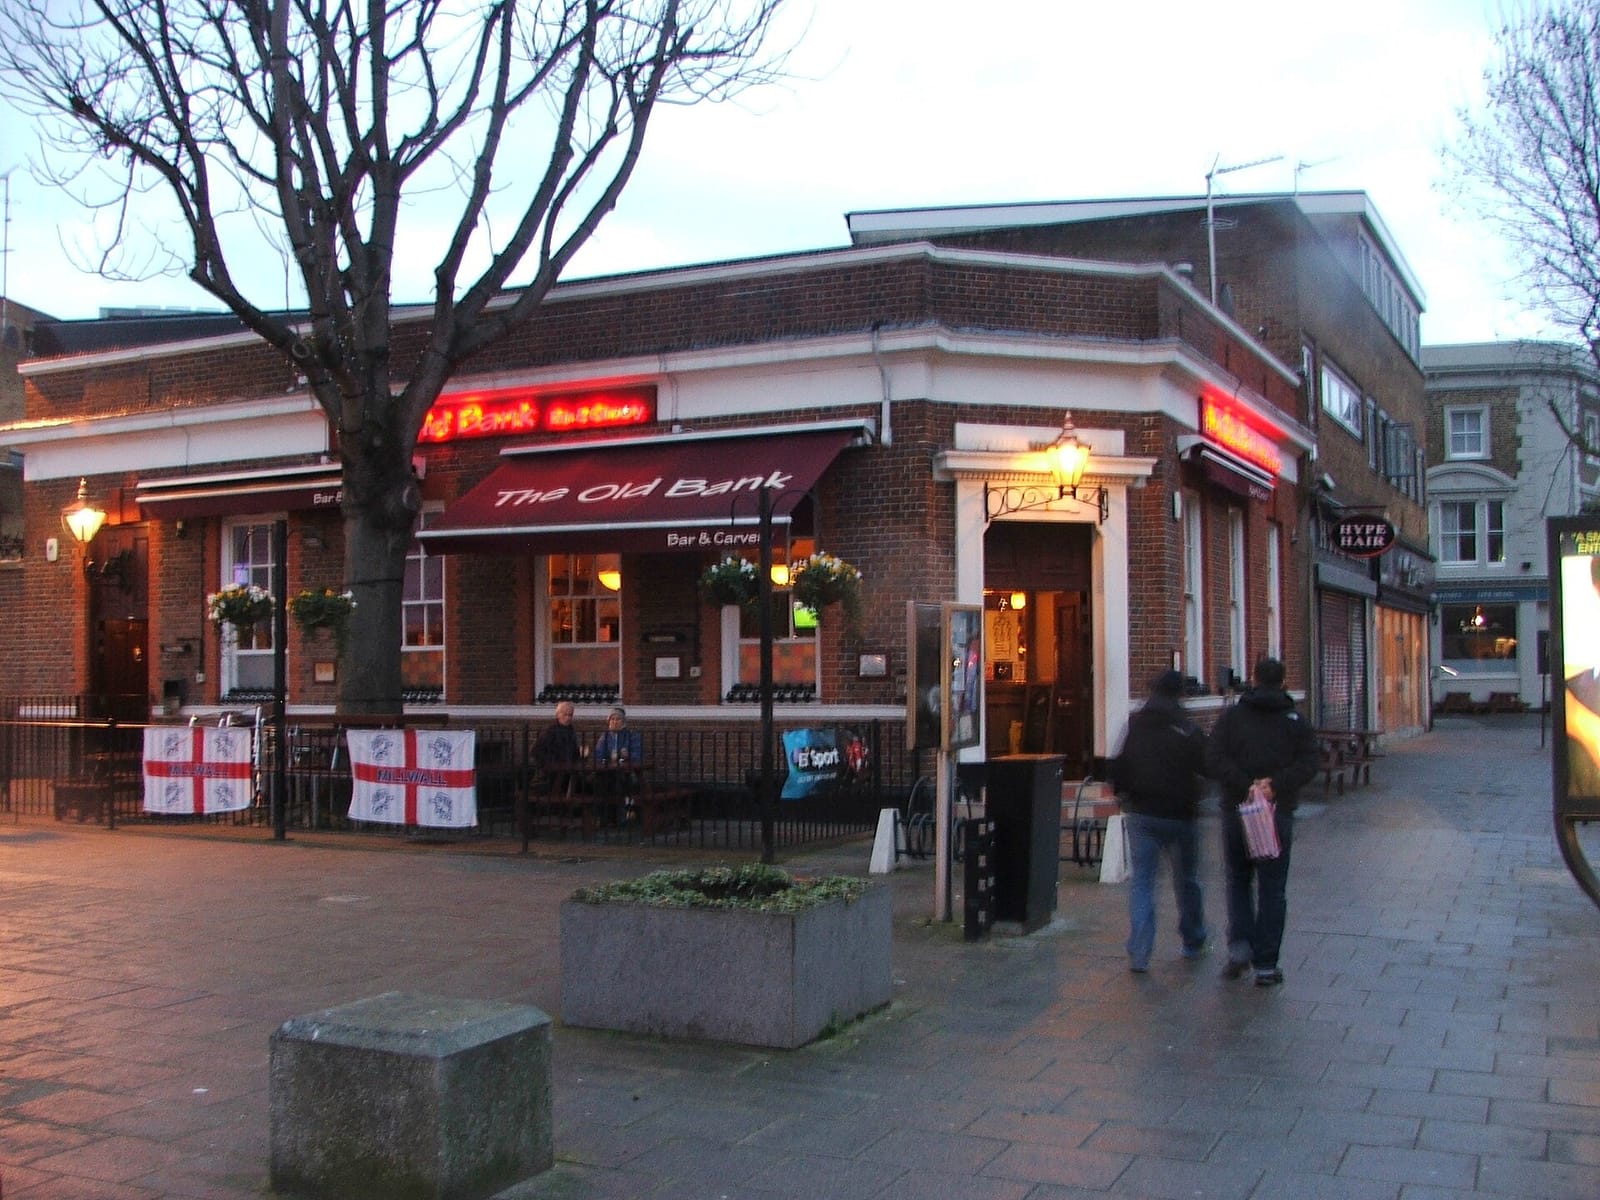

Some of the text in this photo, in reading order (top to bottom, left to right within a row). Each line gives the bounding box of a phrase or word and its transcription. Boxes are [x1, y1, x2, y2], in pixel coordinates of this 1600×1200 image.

[417, 408, 450, 438] ld
[457, 401, 535, 434] Bank
[494, 470, 793, 508] The Old Bank
[313, 493, 334, 505] Bar
[1340, 524, 1387, 535] HYPE
[667, 531, 760, 547] Bar & Carve
[1340, 535, 1386, 547] HAIR
[810, 747, 840, 769] Sport
[376, 768, 448, 785] MILLWALL
